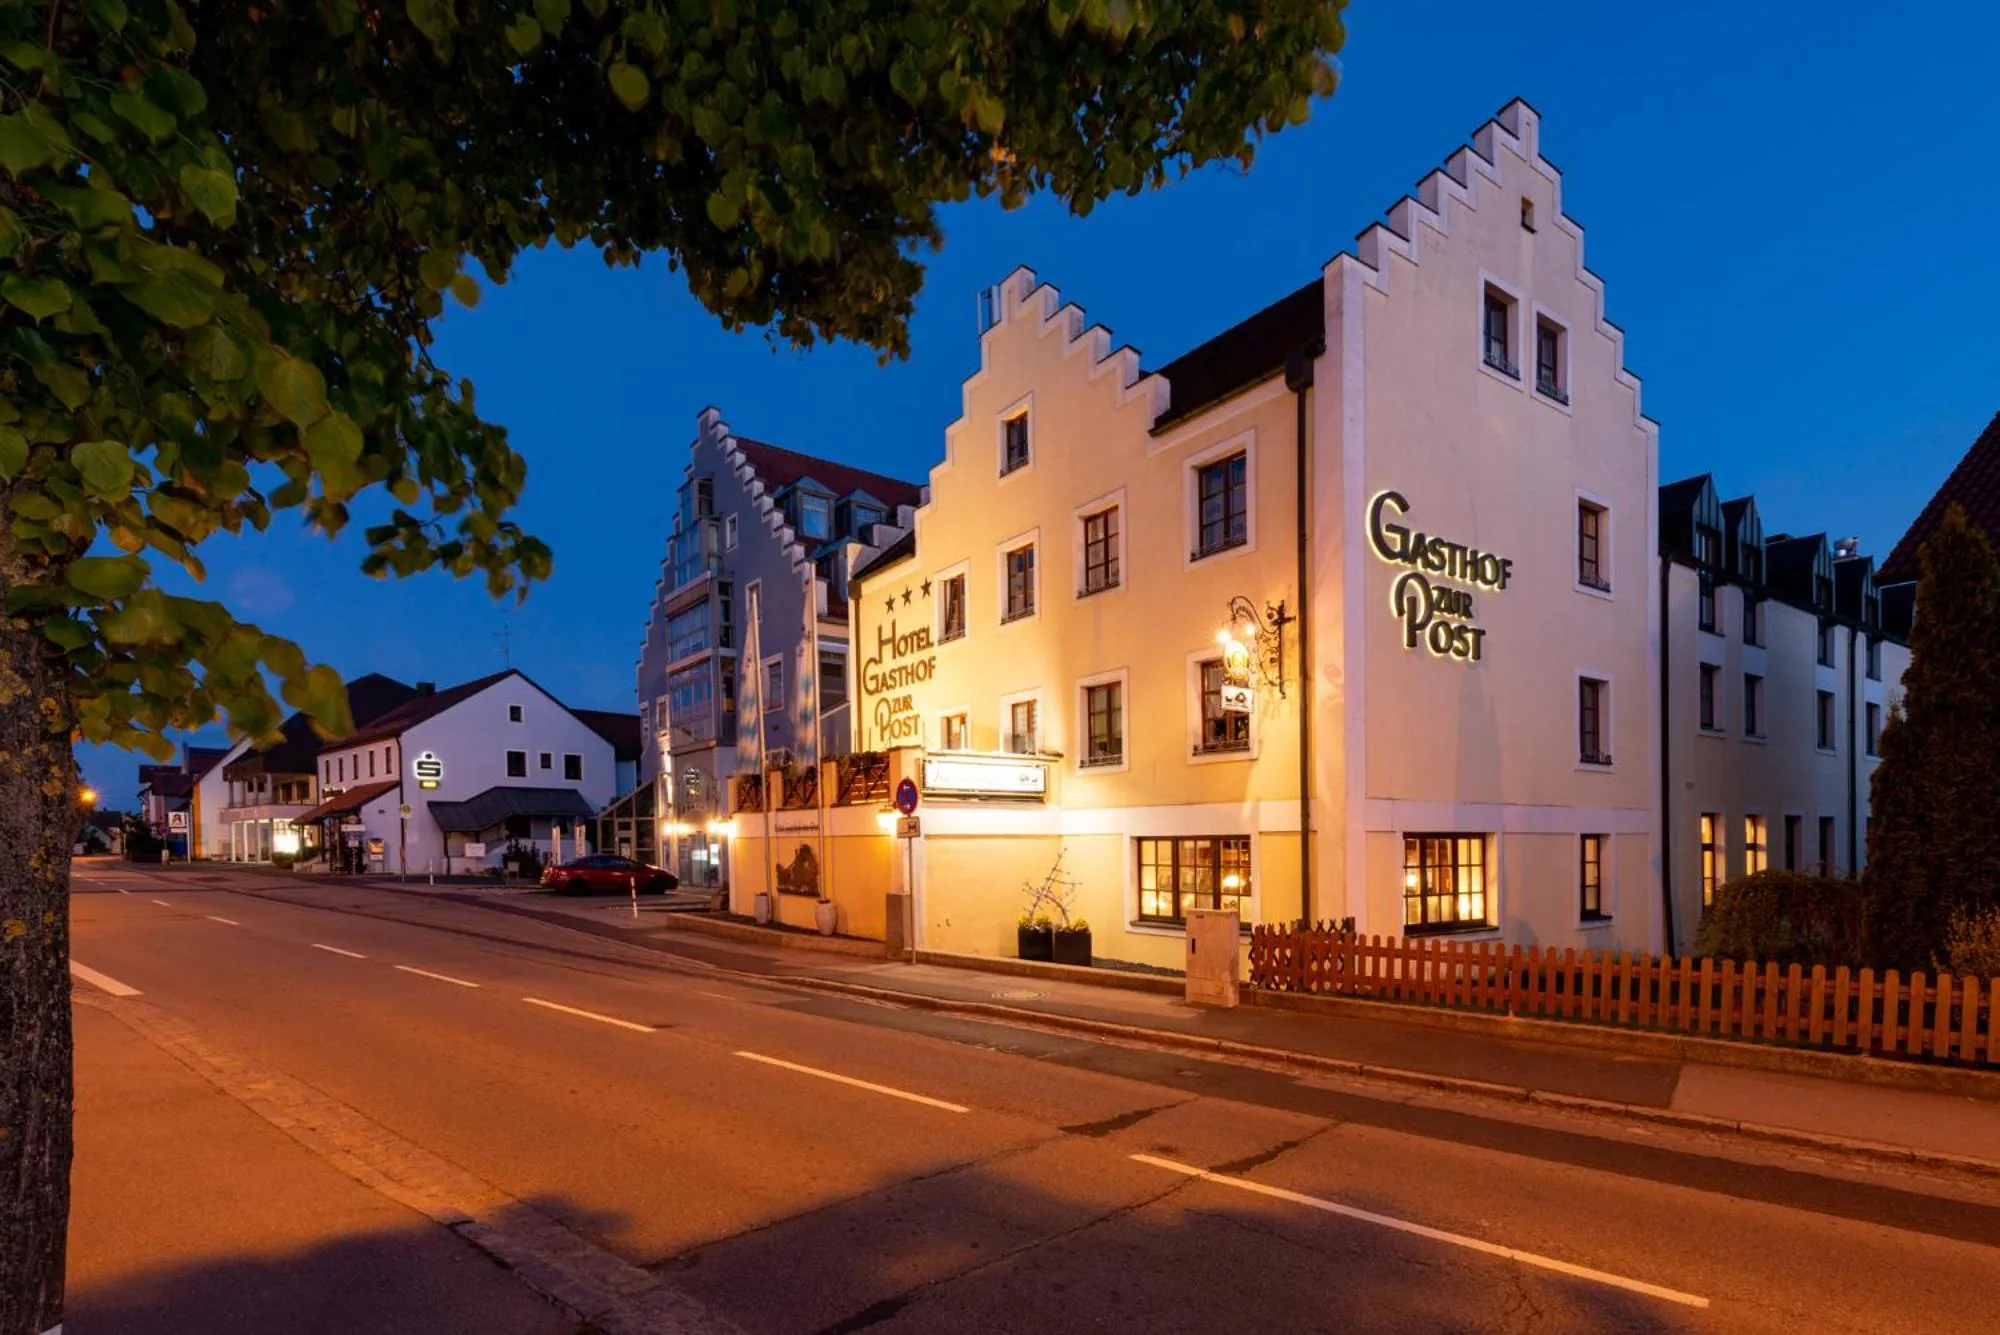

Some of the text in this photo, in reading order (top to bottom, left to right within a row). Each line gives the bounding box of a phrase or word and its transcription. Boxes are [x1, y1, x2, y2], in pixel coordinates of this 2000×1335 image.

[1369, 490, 1513, 590] GASTHOF
[1393, 571, 1487, 661] POST
[1431, 585, 1474, 619] ZUR
[877, 619, 934, 664] HOTEL
[863, 657, 936, 696] GASTHOF
[874, 697, 921, 742] POST
[891, 694, 914, 714] ZUR
